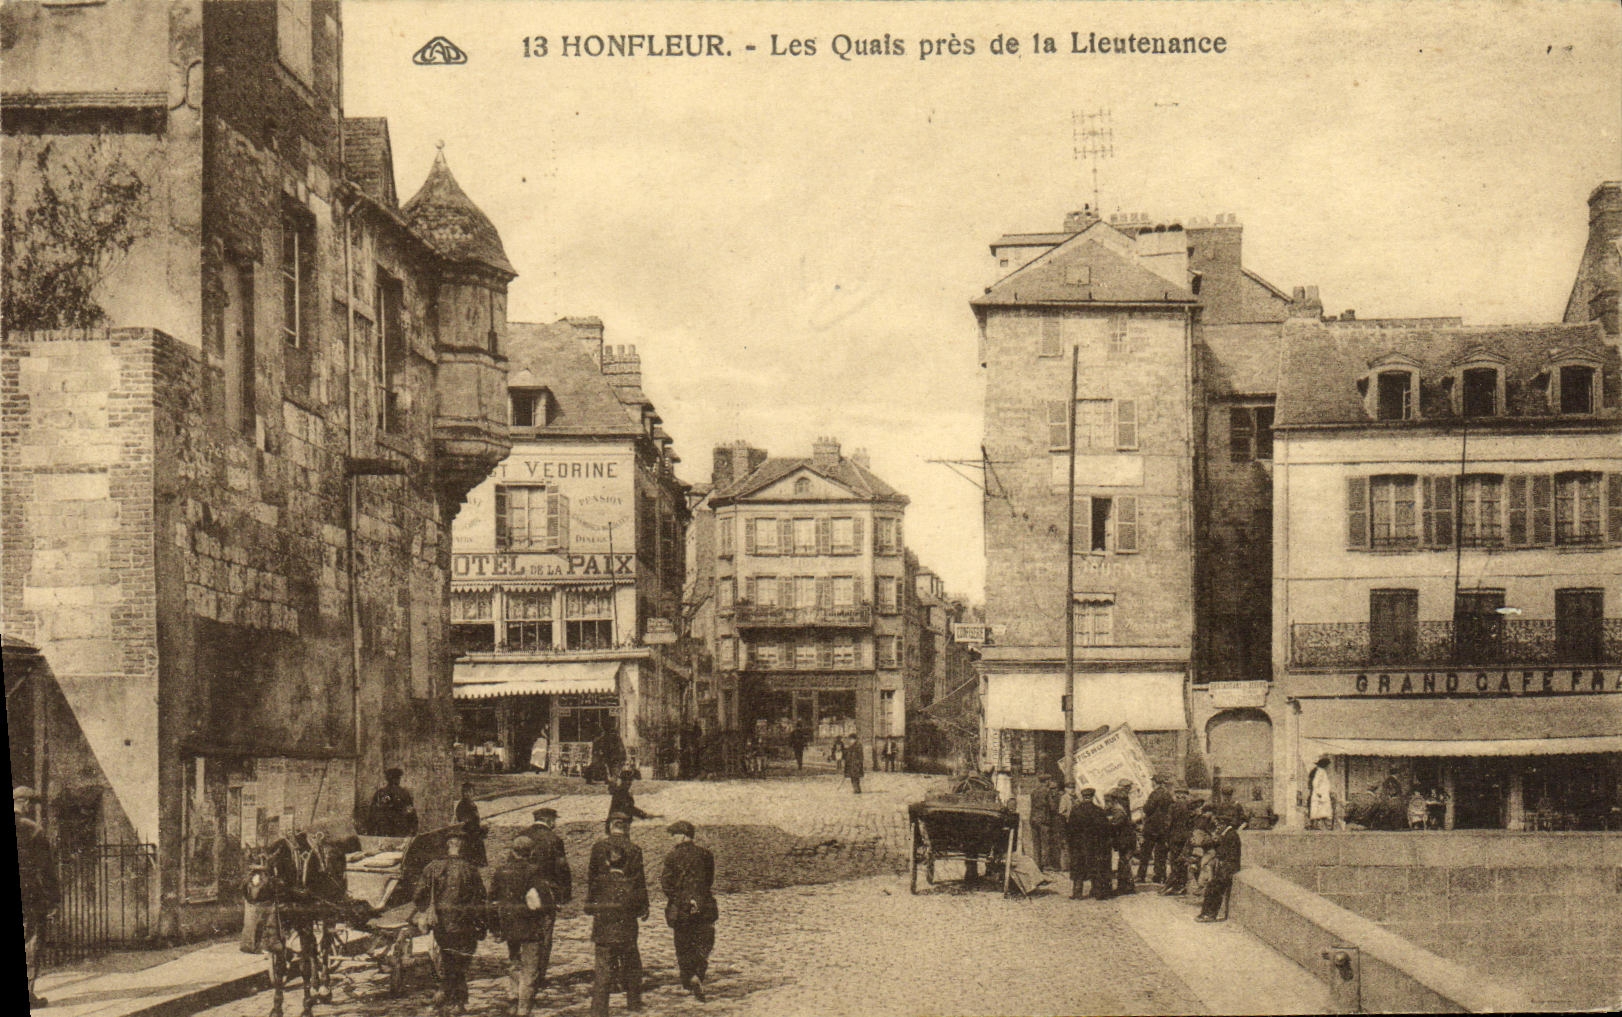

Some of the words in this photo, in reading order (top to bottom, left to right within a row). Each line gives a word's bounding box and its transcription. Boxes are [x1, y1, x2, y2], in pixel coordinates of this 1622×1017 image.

[524, 461, 618, 478] VEDRINE
[453, 554, 525, 576] OTEL
[530, 564, 545, 575] DE
[547, 565, 562, 575] LA
[566, 554, 634, 575] PAIX
[1356, 672, 1459, 694] GRAND
[1476, 671, 1553, 692] CAFE
